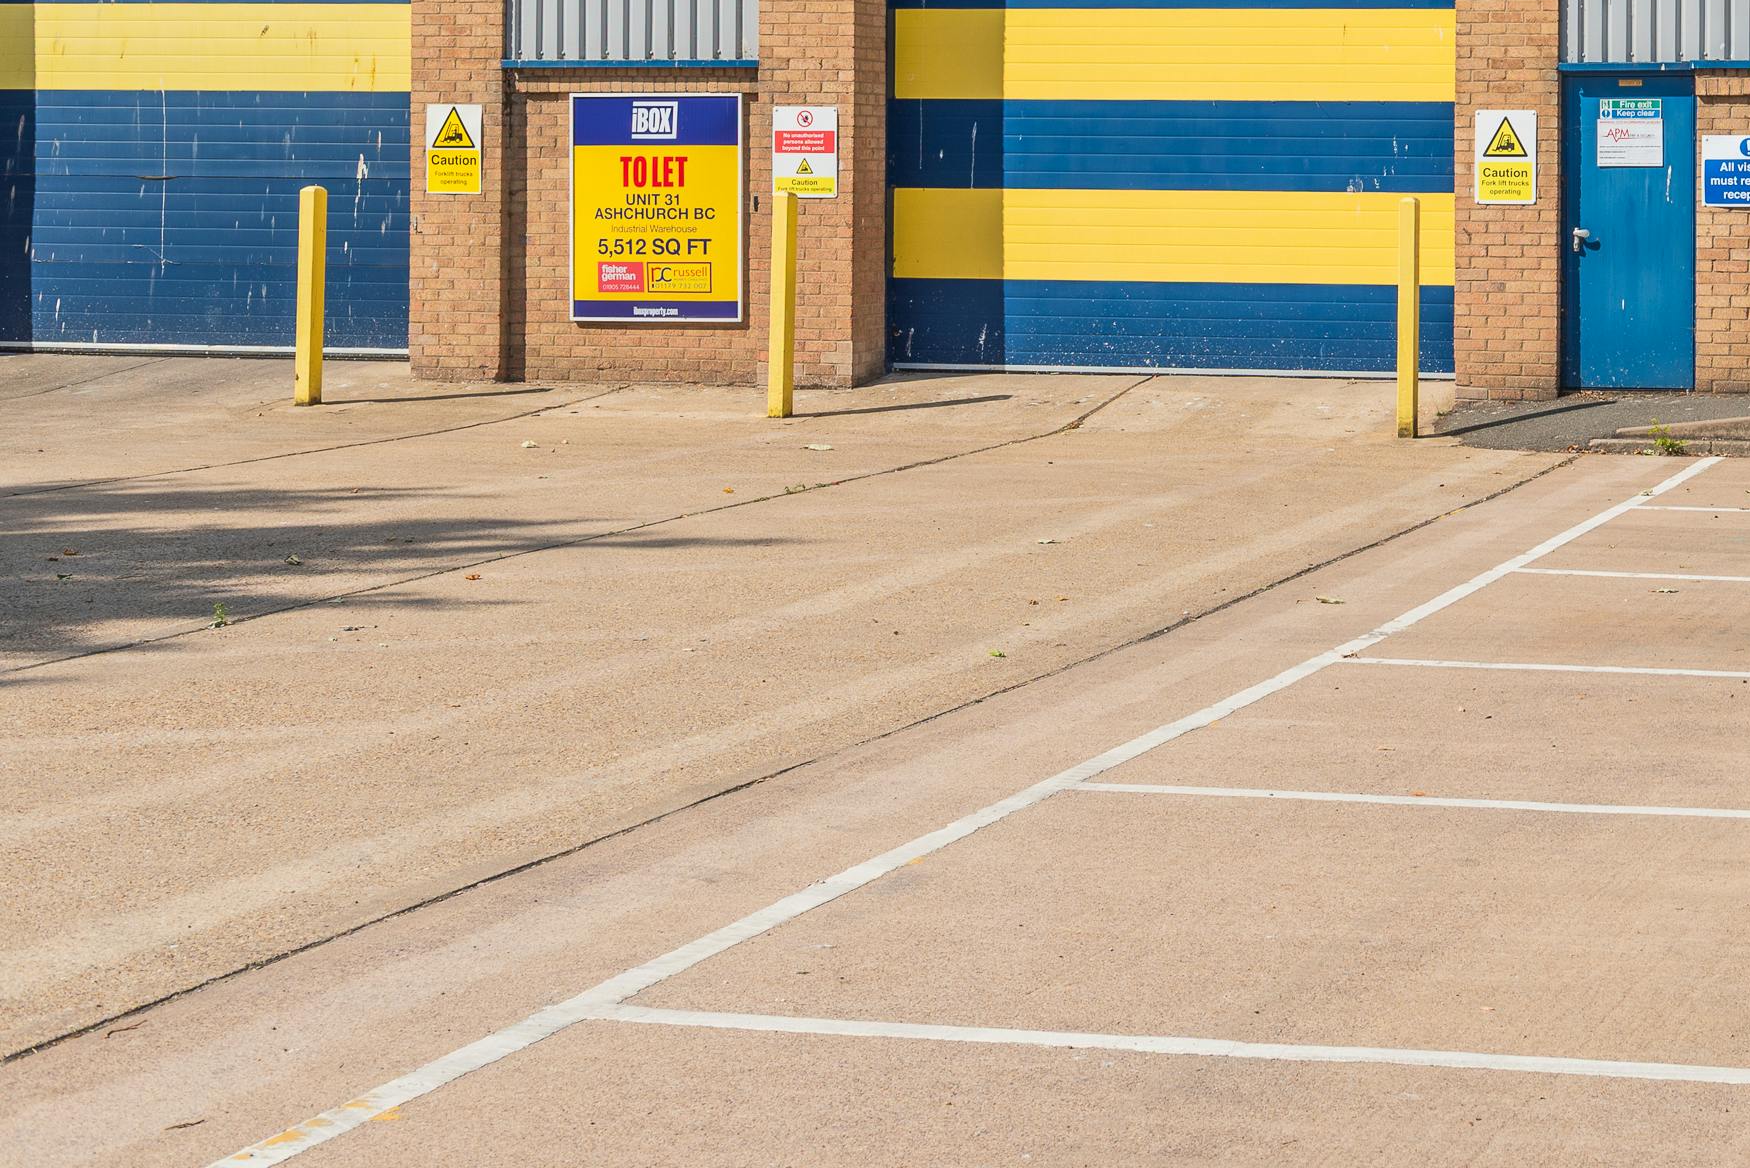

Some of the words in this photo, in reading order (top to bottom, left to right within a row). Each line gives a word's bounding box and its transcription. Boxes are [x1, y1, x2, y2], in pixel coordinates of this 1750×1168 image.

[1616, 110, 1635, 118] Keep
[632, 107, 672, 133] iBOX
[1608, 128, 1630, 138] APM
[431, 155, 477, 165] Caution
[1720, 162, 1734, 171] All
[620, 156, 647, 187] TO
[652, 156, 688, 187] LET
[1483, 168, 1528, 177] Caution
[1711, 176, 1737, 185] must
[1489, 188, 1521, 196] operating
[626, 194, 660, 205] UNIT
[665, 194, 680, 205] 31
[595, 208, 689, 220] ASHCHURCH
[694, 208, 716, 220] BC
[611, 225, 647, 233] Industrial
[650, 225, 697, 233] Warehouse
[598, 239, 646, 258] 5,512
[652, 239, 680, 256] SQ
[688, 239, 712, 255] FT
[602, 265, 628, 273] fisher
[673, 266, 708, 277] russell
[602, 273, 636, 282] german
